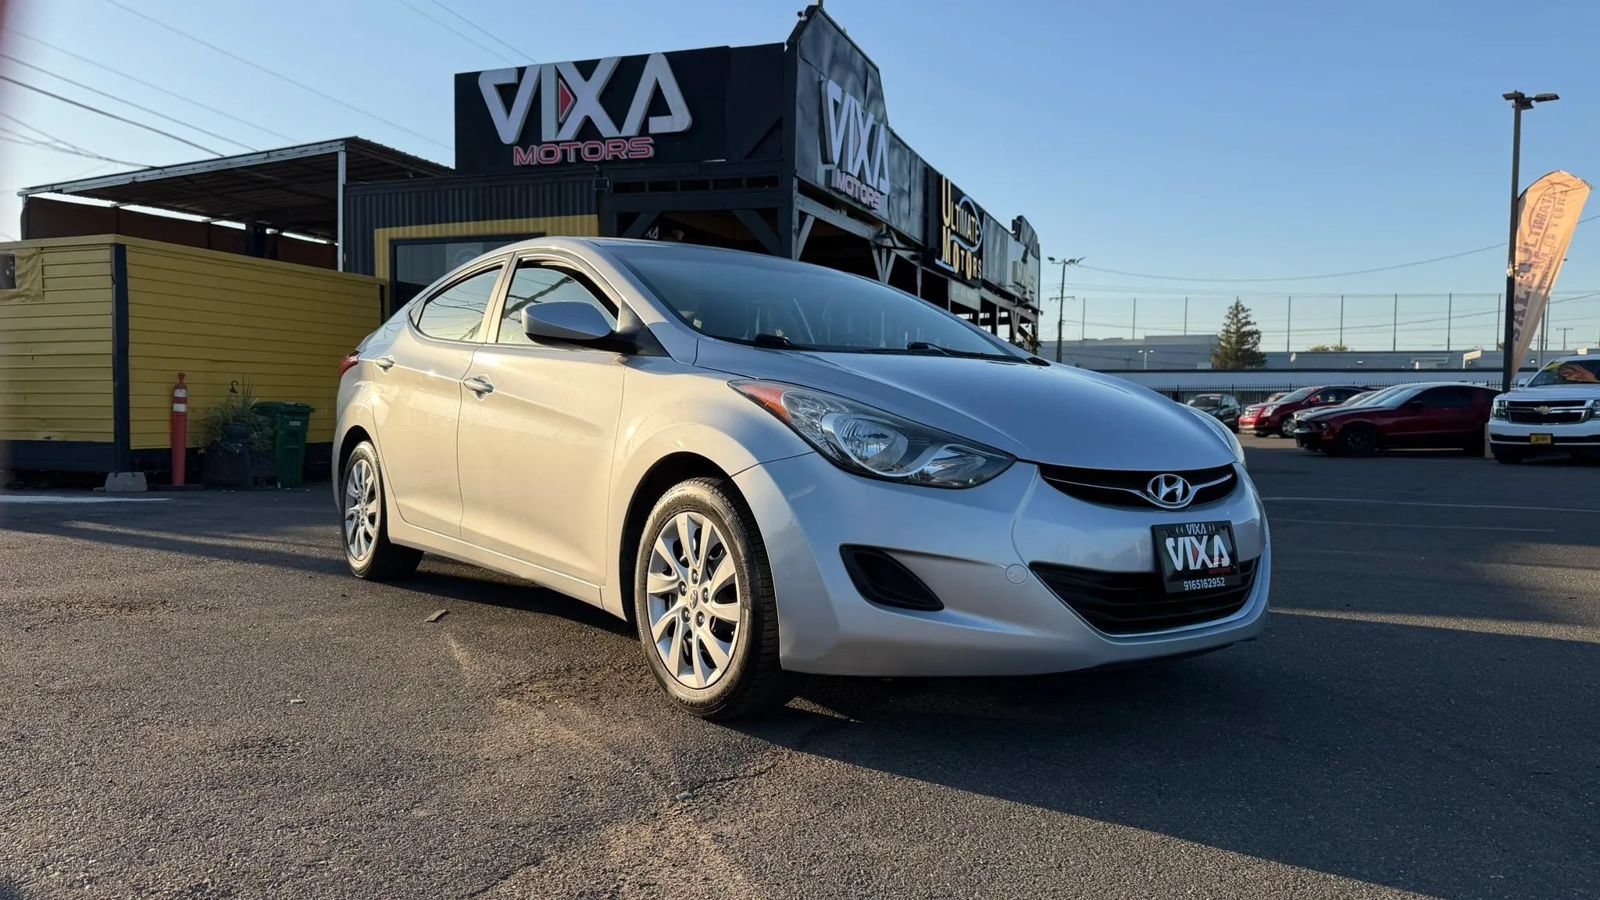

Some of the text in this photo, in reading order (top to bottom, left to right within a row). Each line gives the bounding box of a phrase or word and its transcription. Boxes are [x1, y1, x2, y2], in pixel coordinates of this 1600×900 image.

[478, 52, 692, 145] VIXA
[513, 137, 654, 166] MOTORS
[826, 79, 890, 195] VIXA
[834, 168, 882, 212] MOTORS
[942, 176, 980, 244] ULTIMATE
[942, 226, 982, 280] MOTORS
[1185, 523, 1207, 535] VIXA
[1165, 534, 1231, 571] VIXA
[1183, 577, 1226, 591] 9165162952
